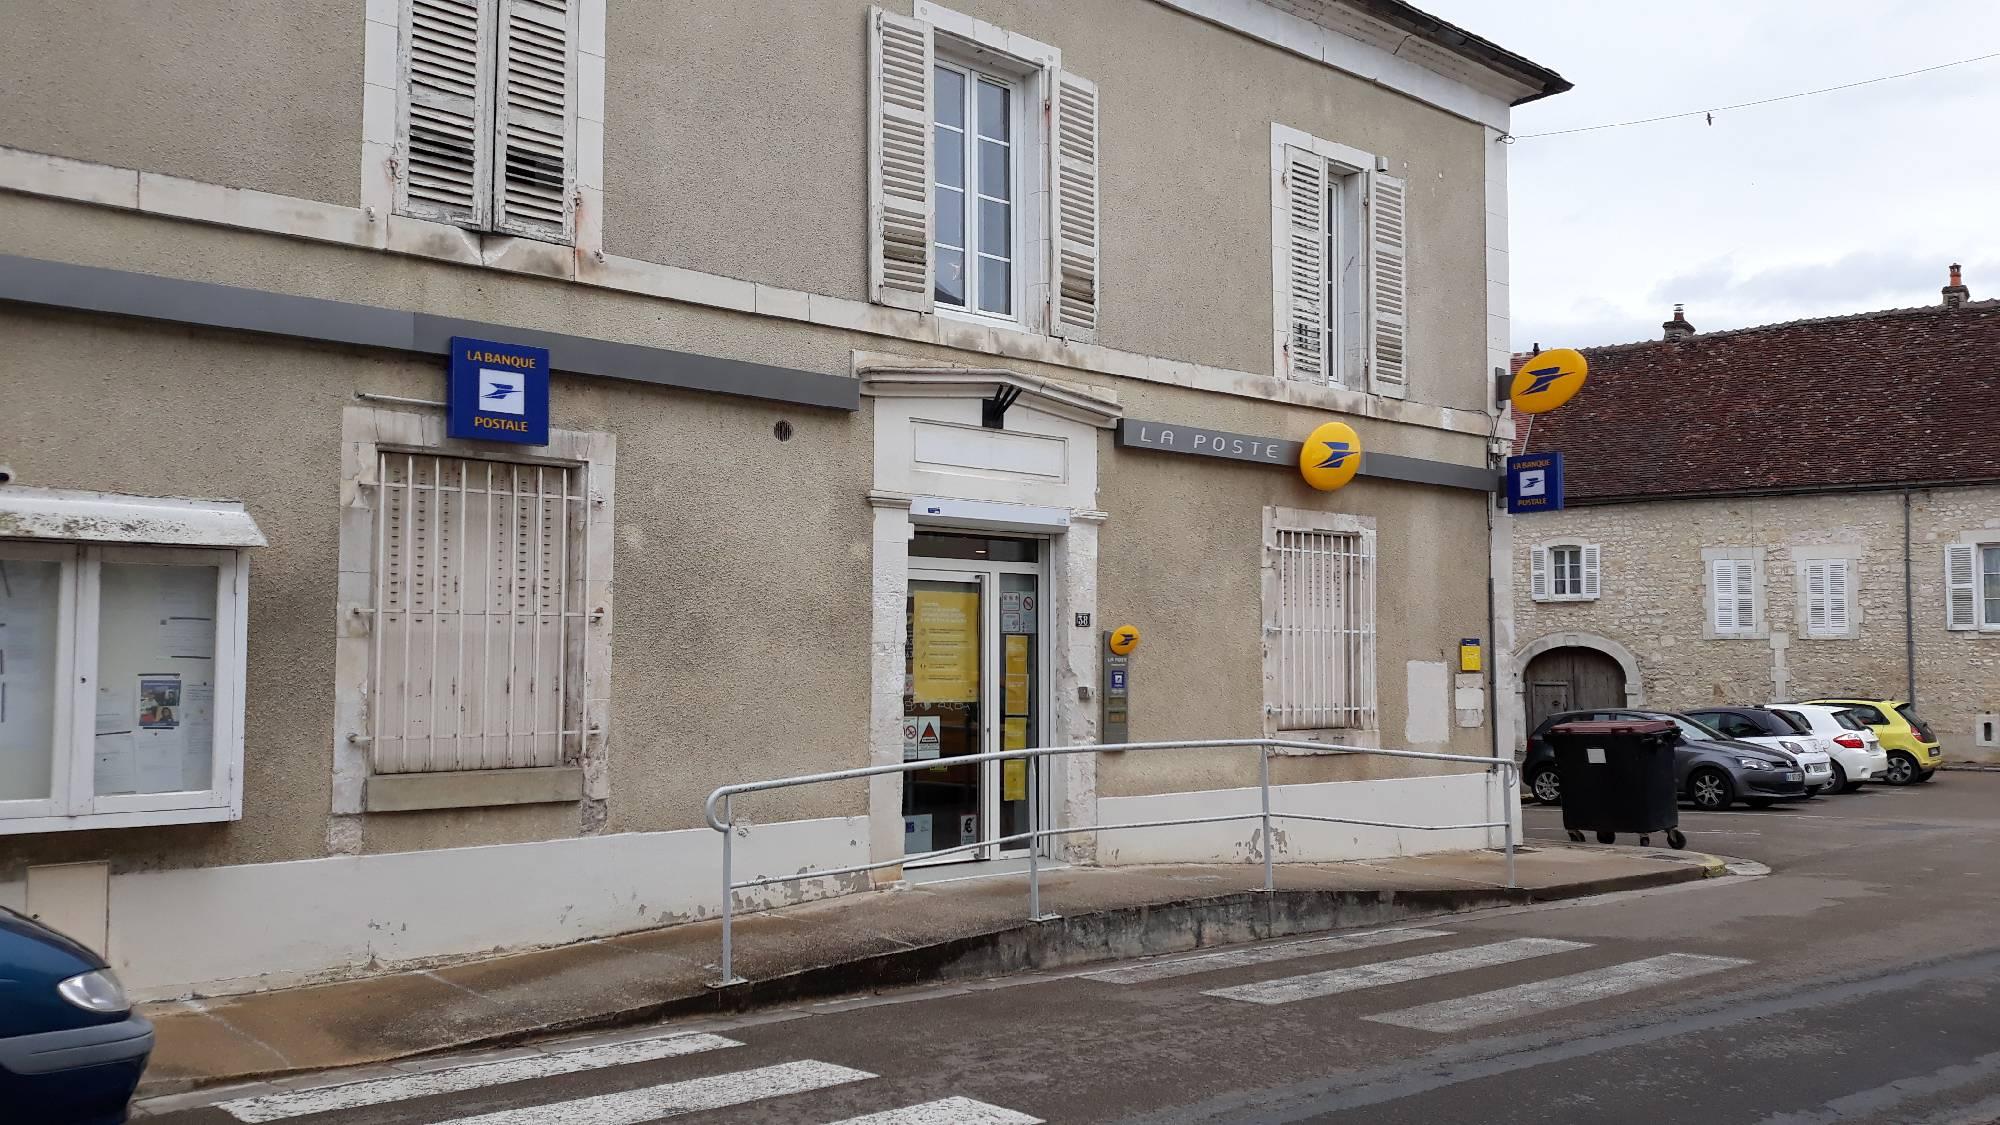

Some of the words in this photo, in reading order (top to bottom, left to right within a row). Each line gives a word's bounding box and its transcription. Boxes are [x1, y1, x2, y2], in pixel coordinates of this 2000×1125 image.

[467, 350, 482, 362] LA
[484, 352, 536, 369] BANQUE
[474, 416, 528, 432] POSTALE
[1140, 426, 1175, 445] LA
[1193, 433, 1280, 459] POSTE
